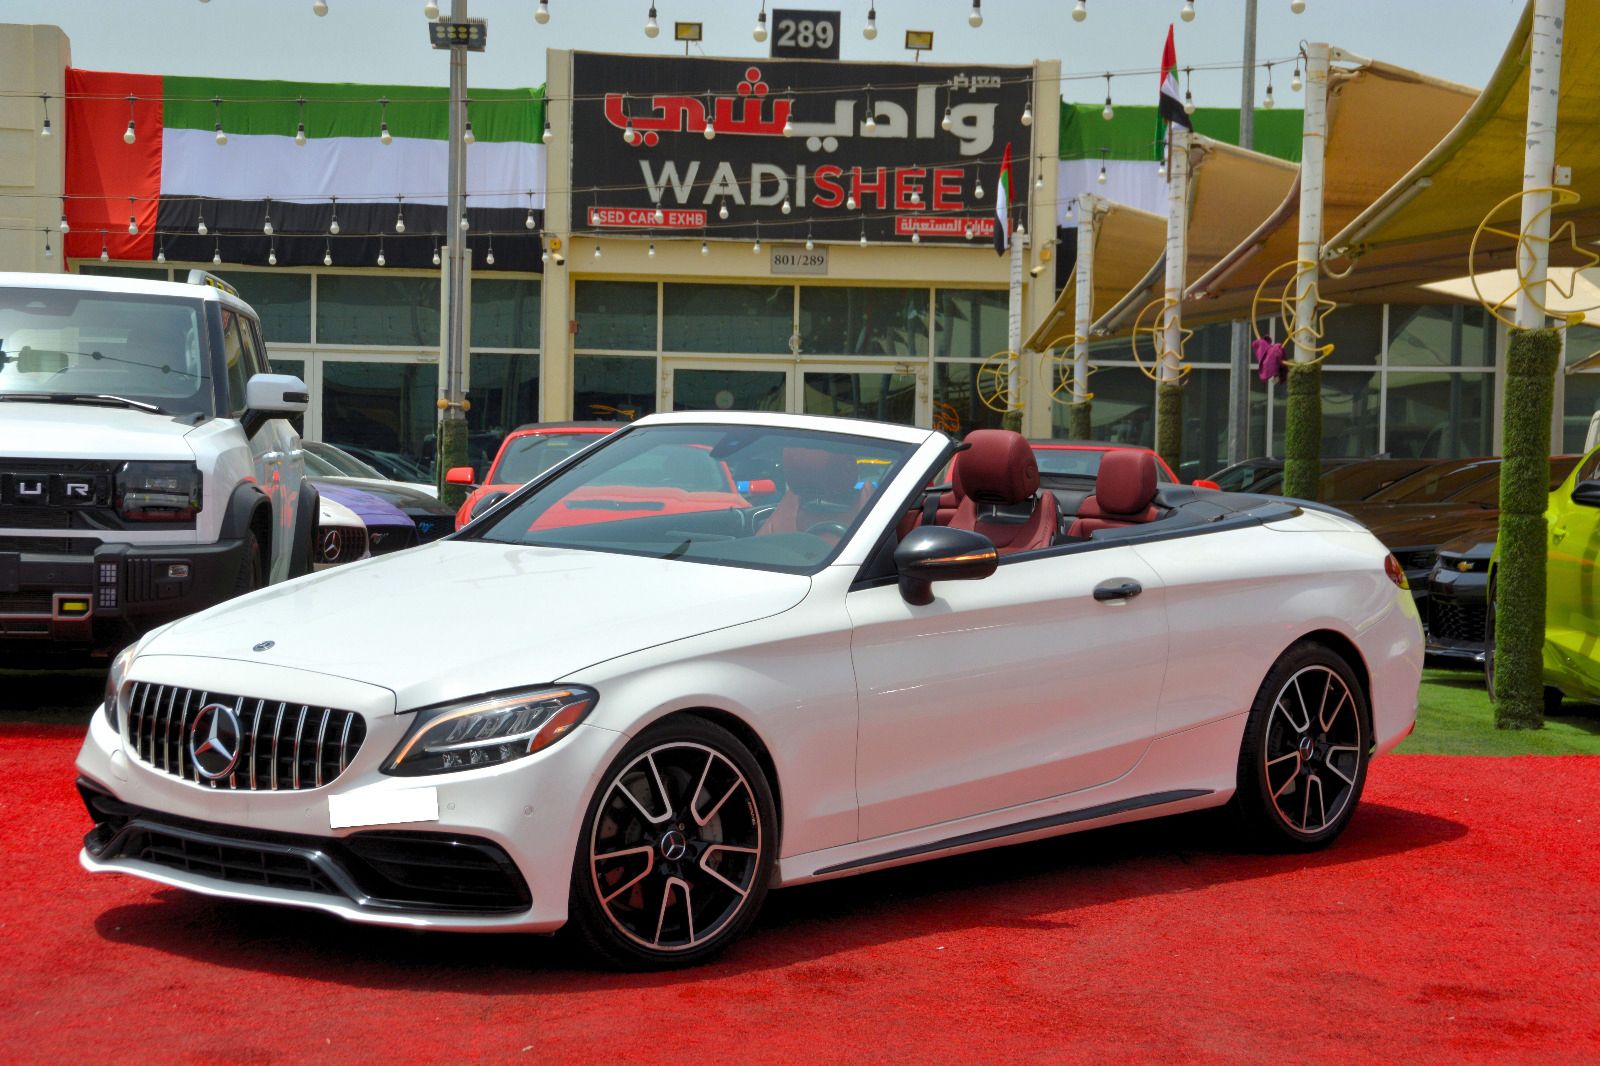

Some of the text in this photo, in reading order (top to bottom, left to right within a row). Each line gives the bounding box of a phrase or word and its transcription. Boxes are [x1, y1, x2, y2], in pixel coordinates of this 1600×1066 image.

[778, 19, 834, 49] 289
[949, 72, 1001, 93] معرض
[669, 212, 704, 226] EXHB
[774, 254, 825, 266] 801/289
